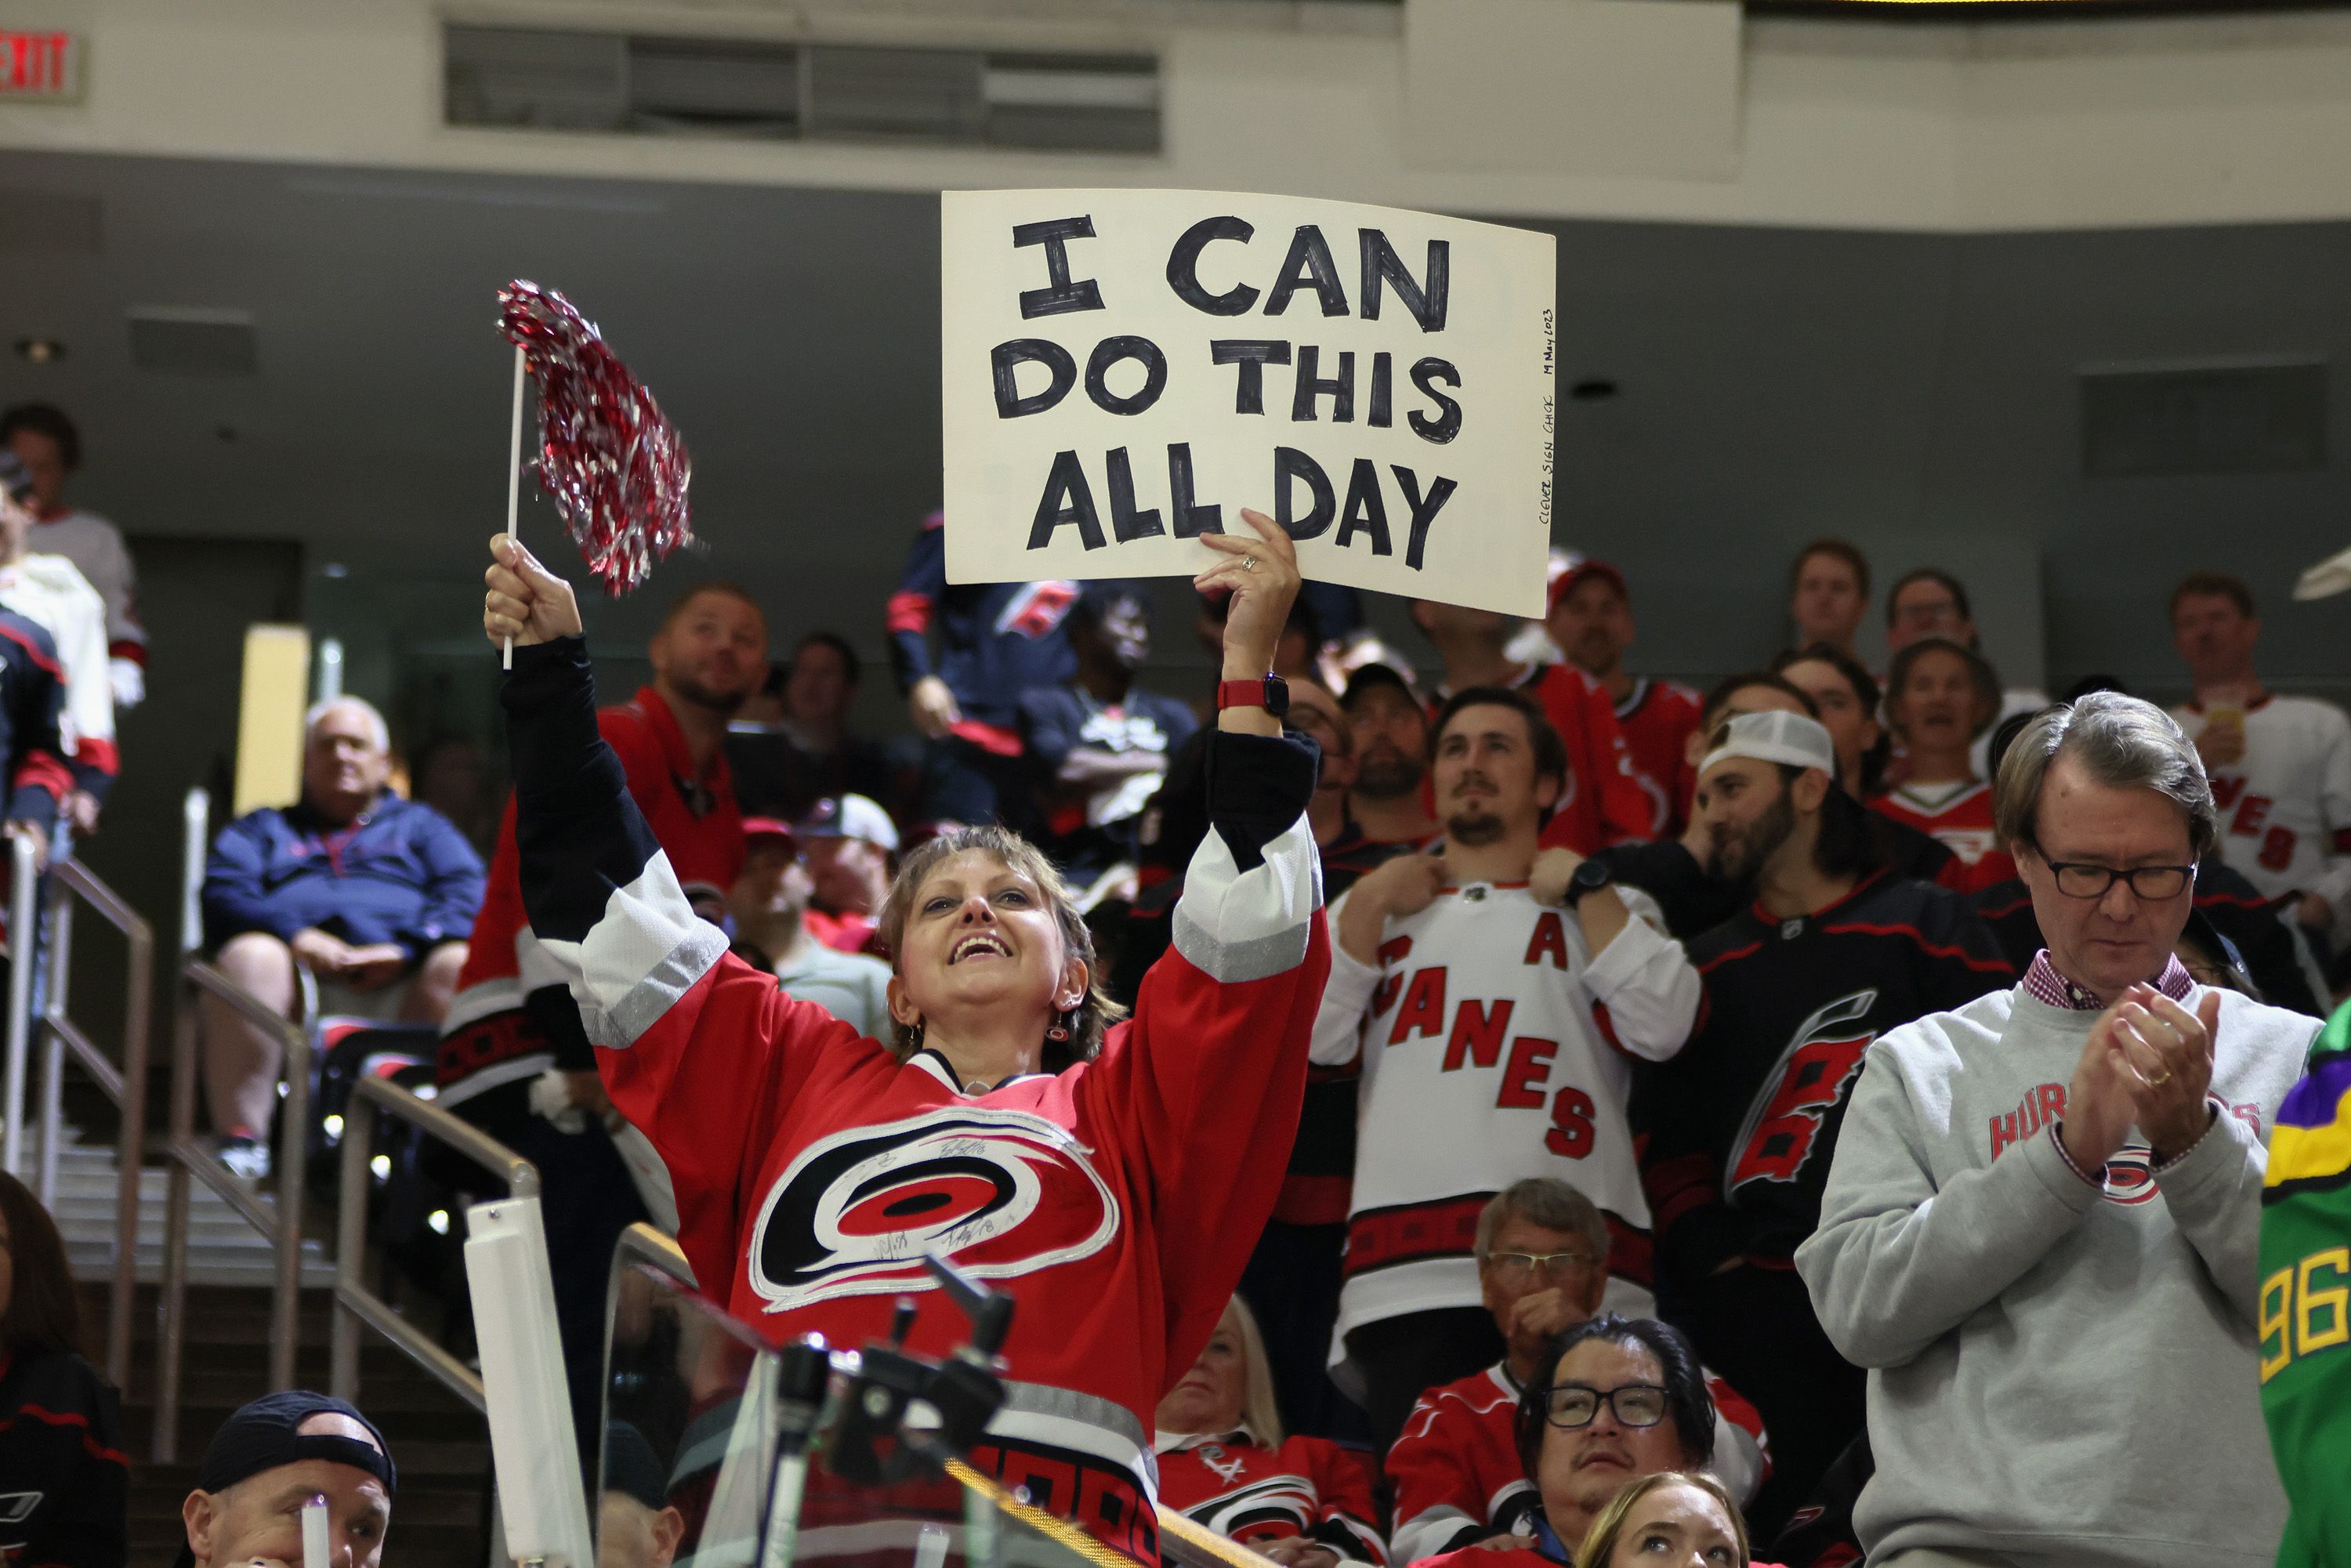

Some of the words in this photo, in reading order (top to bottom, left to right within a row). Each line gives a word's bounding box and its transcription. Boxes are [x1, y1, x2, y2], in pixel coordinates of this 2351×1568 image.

[1012, 214, 1107, 320] I
[1165, 215, 1450, 334] CAN
[1542, 308, 1553, 335] 2023
[1543, 339, 1556, 361] May
[990, 335, 1168, 419] DO
[1210, 339, 1462, 445] THIS
[1542, 395, 1553, 434] CHICK
[1541, 442, 1552, 475] SIGN
[1026, 442, 1226, 552] ALL
[1273, 445, 1458, 572] DAY
[1538, 480, 1551, 525] CLEVER
[1523, 911, 1568, 972] A
[2259, 1244, 2350, 1385] 96
